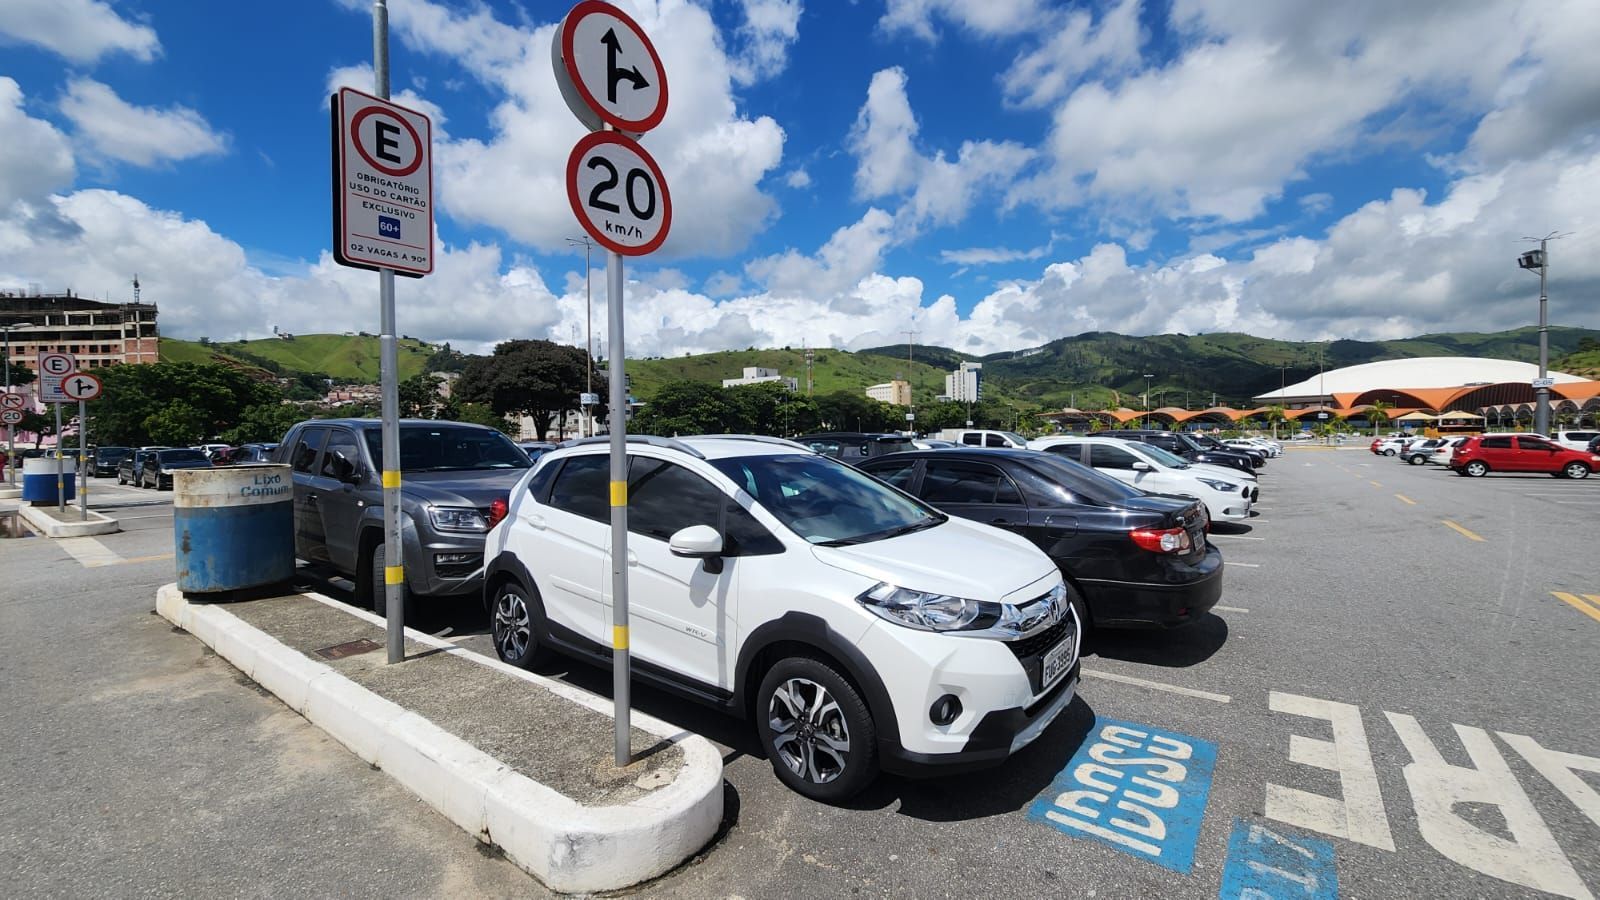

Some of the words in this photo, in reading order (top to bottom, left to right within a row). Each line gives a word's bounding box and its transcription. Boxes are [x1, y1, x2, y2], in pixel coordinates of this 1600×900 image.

[375, 120, 401, 164] E
[356, 172, 420, 195] OBRIGATÓRIO
[587, 156, 656, 221] 20
[349, 181, 370, 193] USO
[373, 188, 387, 197] DO
[390, 192, 426, 208] CARTÃO
[362, 201, 415, 220] EXCLUSIVO
[380, 221, 400, 232] 60+
[605, 220, 643, 239] km/h
[350, 243, 364, 252] 02
[367, 246, 399, 259] VAGAS
[401, 253, 408, 261] A
[51, 359, 63, 371] E
[4, 412, 20, 420] 20
[254, 473, 281, 485] Lixo
[240, 485, 289, 497] Comum
[1045, 725, 1193, 857] IDOSO
